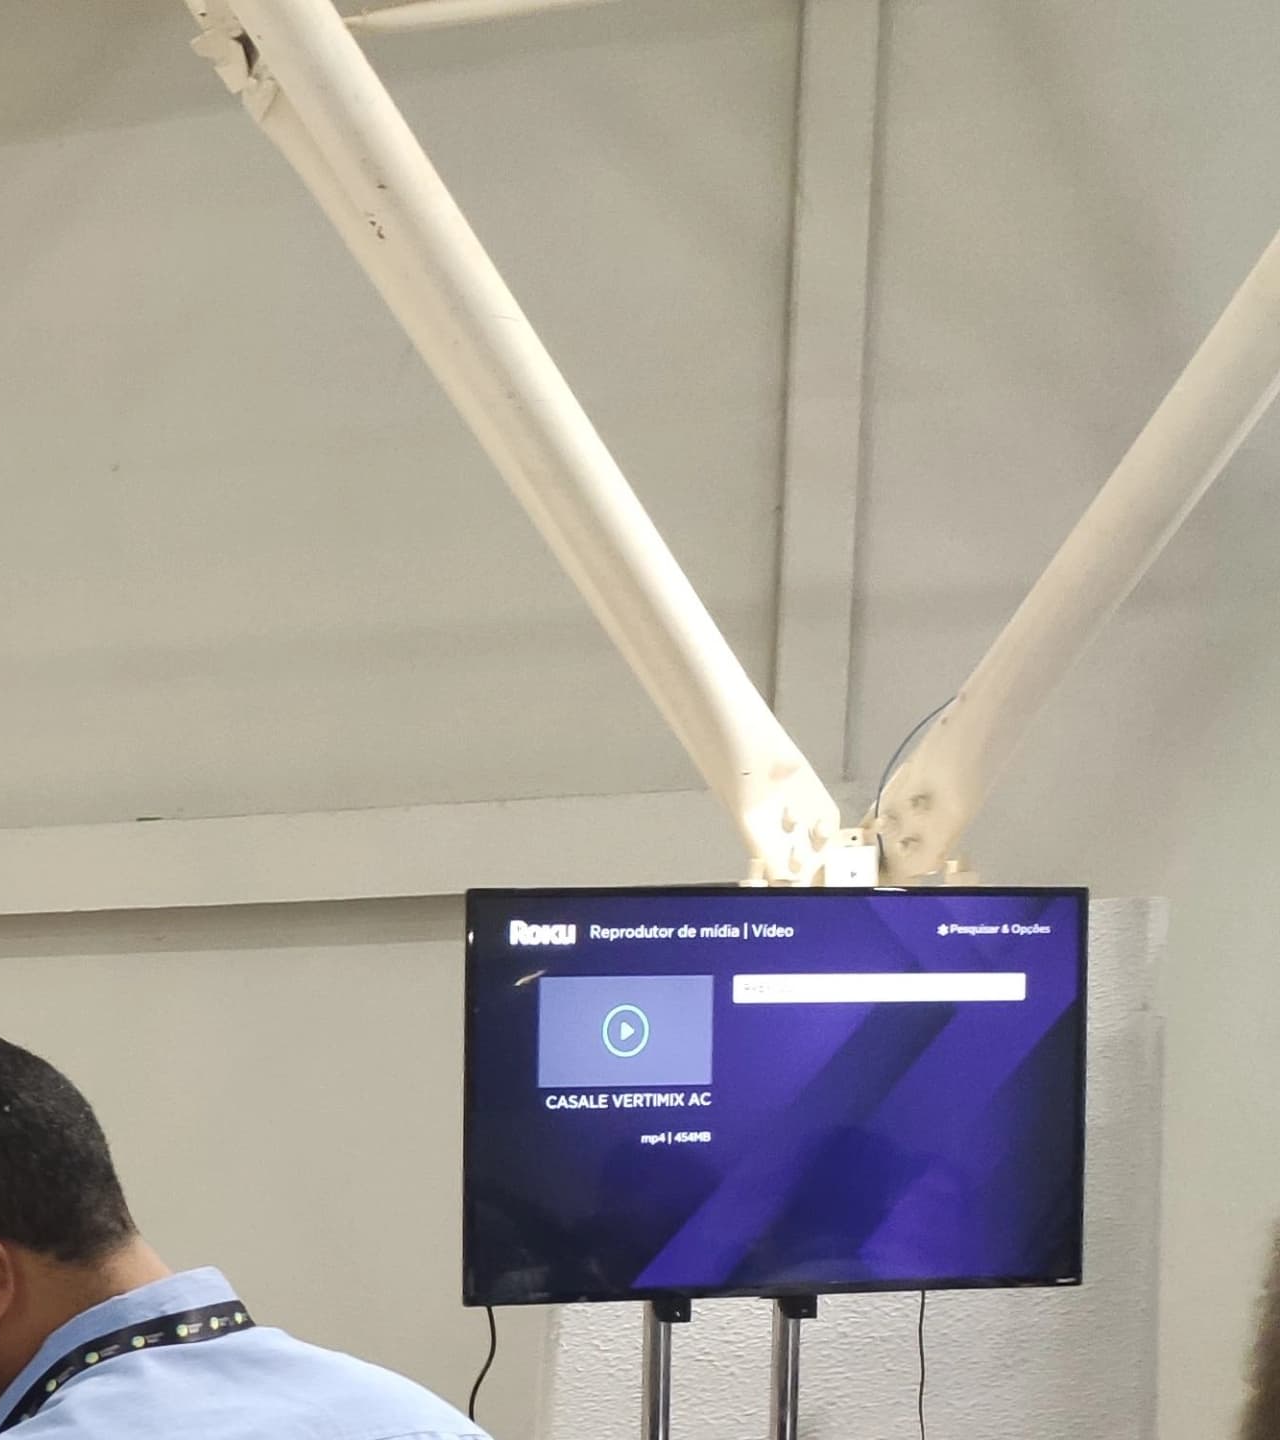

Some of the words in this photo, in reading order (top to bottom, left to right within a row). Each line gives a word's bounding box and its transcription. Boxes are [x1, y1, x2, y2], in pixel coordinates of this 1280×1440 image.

[590, 924, 673, 941] Reprodutor
[677, 923, 697, 938] de
[700, 922, 740, 938] mídia
[752, 922, 794, 938] Vídeo
[545, 1094, 609, 1110] CASALE
[612, 1092, 685, 1109] VERTIMIX
[688, 1091, 712, 1107] AC
[640, 1132, 665, 1145] mp4
